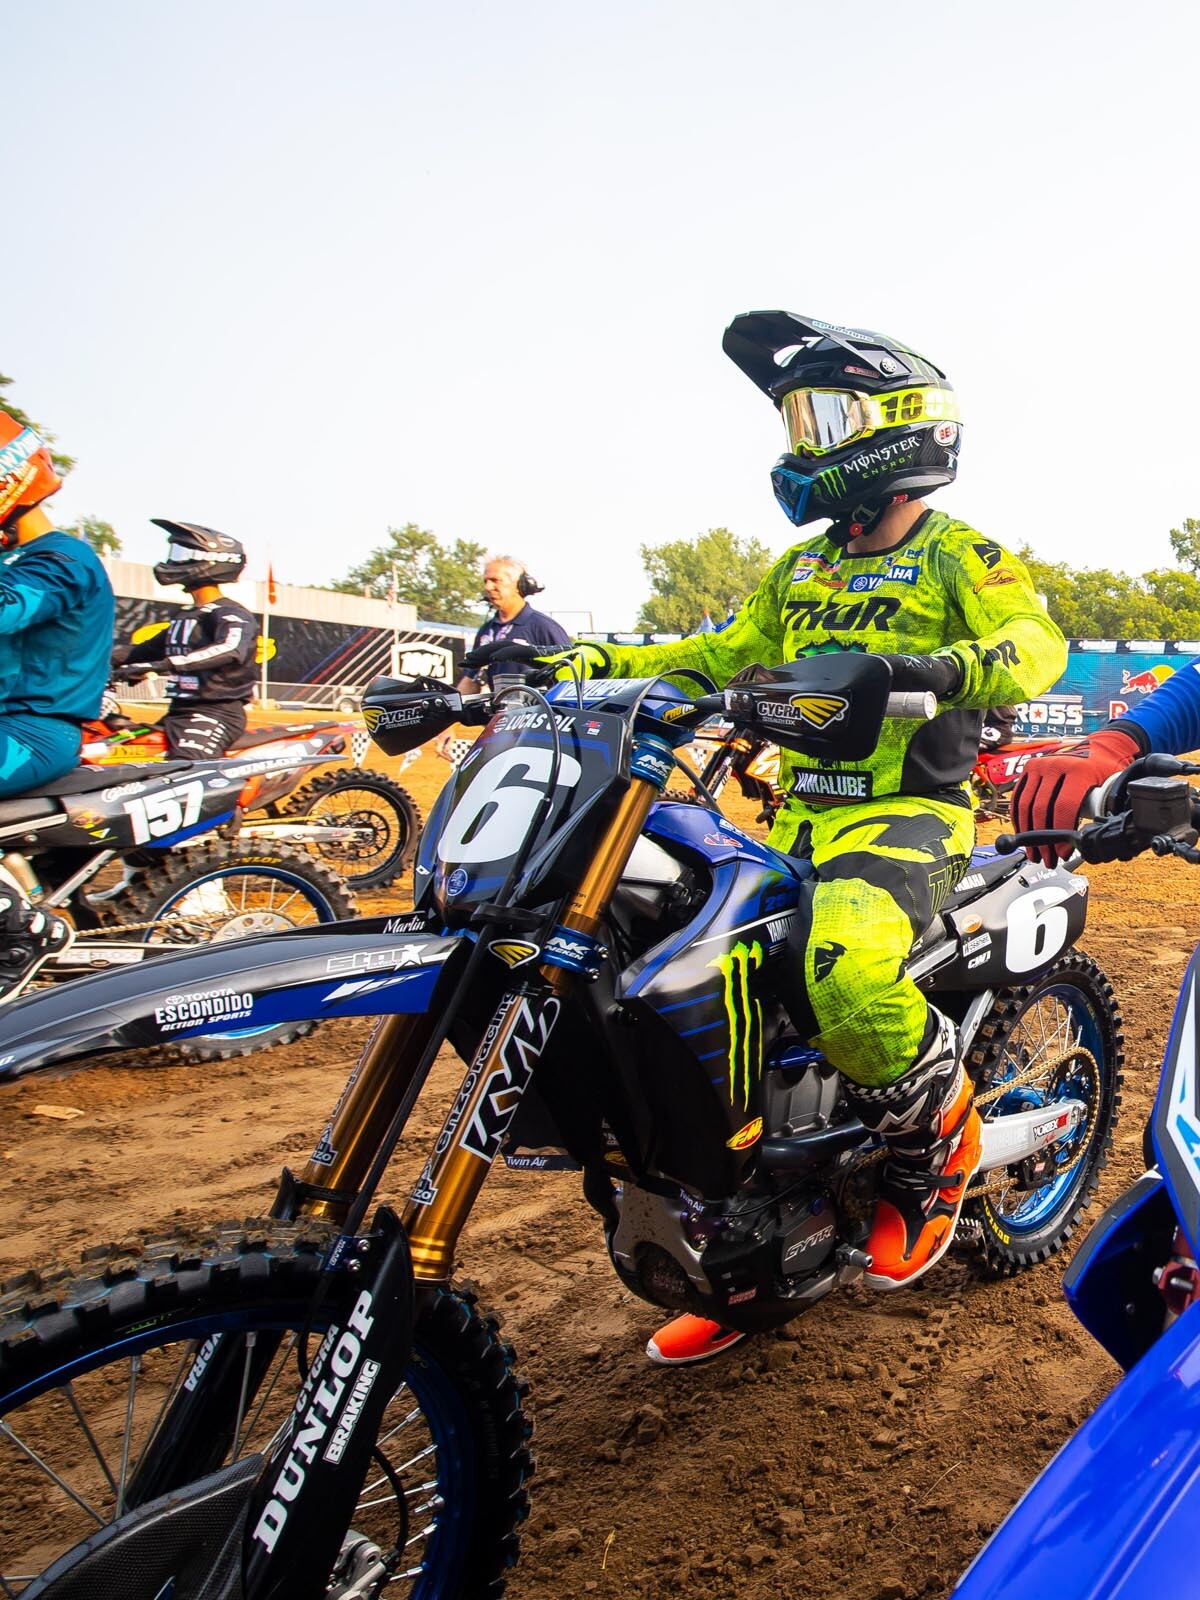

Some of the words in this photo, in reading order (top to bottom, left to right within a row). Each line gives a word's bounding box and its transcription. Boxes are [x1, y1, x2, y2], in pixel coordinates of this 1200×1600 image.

[844, 436, 921, 474] MONSTER
[862, 453, 914, 479] ENERGY
[784, 597, 903, 632] THOR
[401, 651, 446, 678] 100%
[377, 706, 424, 724] CYCRA
[505, 712, 548, 731] LUCAS
[547, 712, 577, 733] OIL
[758, 701, 802, 719] CYCRA
[794, 771, 868, 798] YAMALUBE
[122, 779, 205, 846] 157
[437, 746, 582, 863] 6
[382, 914, 426, 935] Martin
[1006, 886, 1069, 974] 6
[154, 992, 253, 1026] ESCONDIDO
[184, 987, 237, 1002] TOYOTA
[160, 1018, 204, 1032] ACTION
[207, 1009, 252, 1024] SPORTS
[506, 1155, 529, 1167] Twin
[531, 1157, 548, 1167] Air
[784, 1224, 834, 1262] GYTR
[296, 1323, 340, 1414] CYCRA
[252, 1289, 375, 1555] DUNLOP
[325, 1361, 379, 1463] BRAKING
